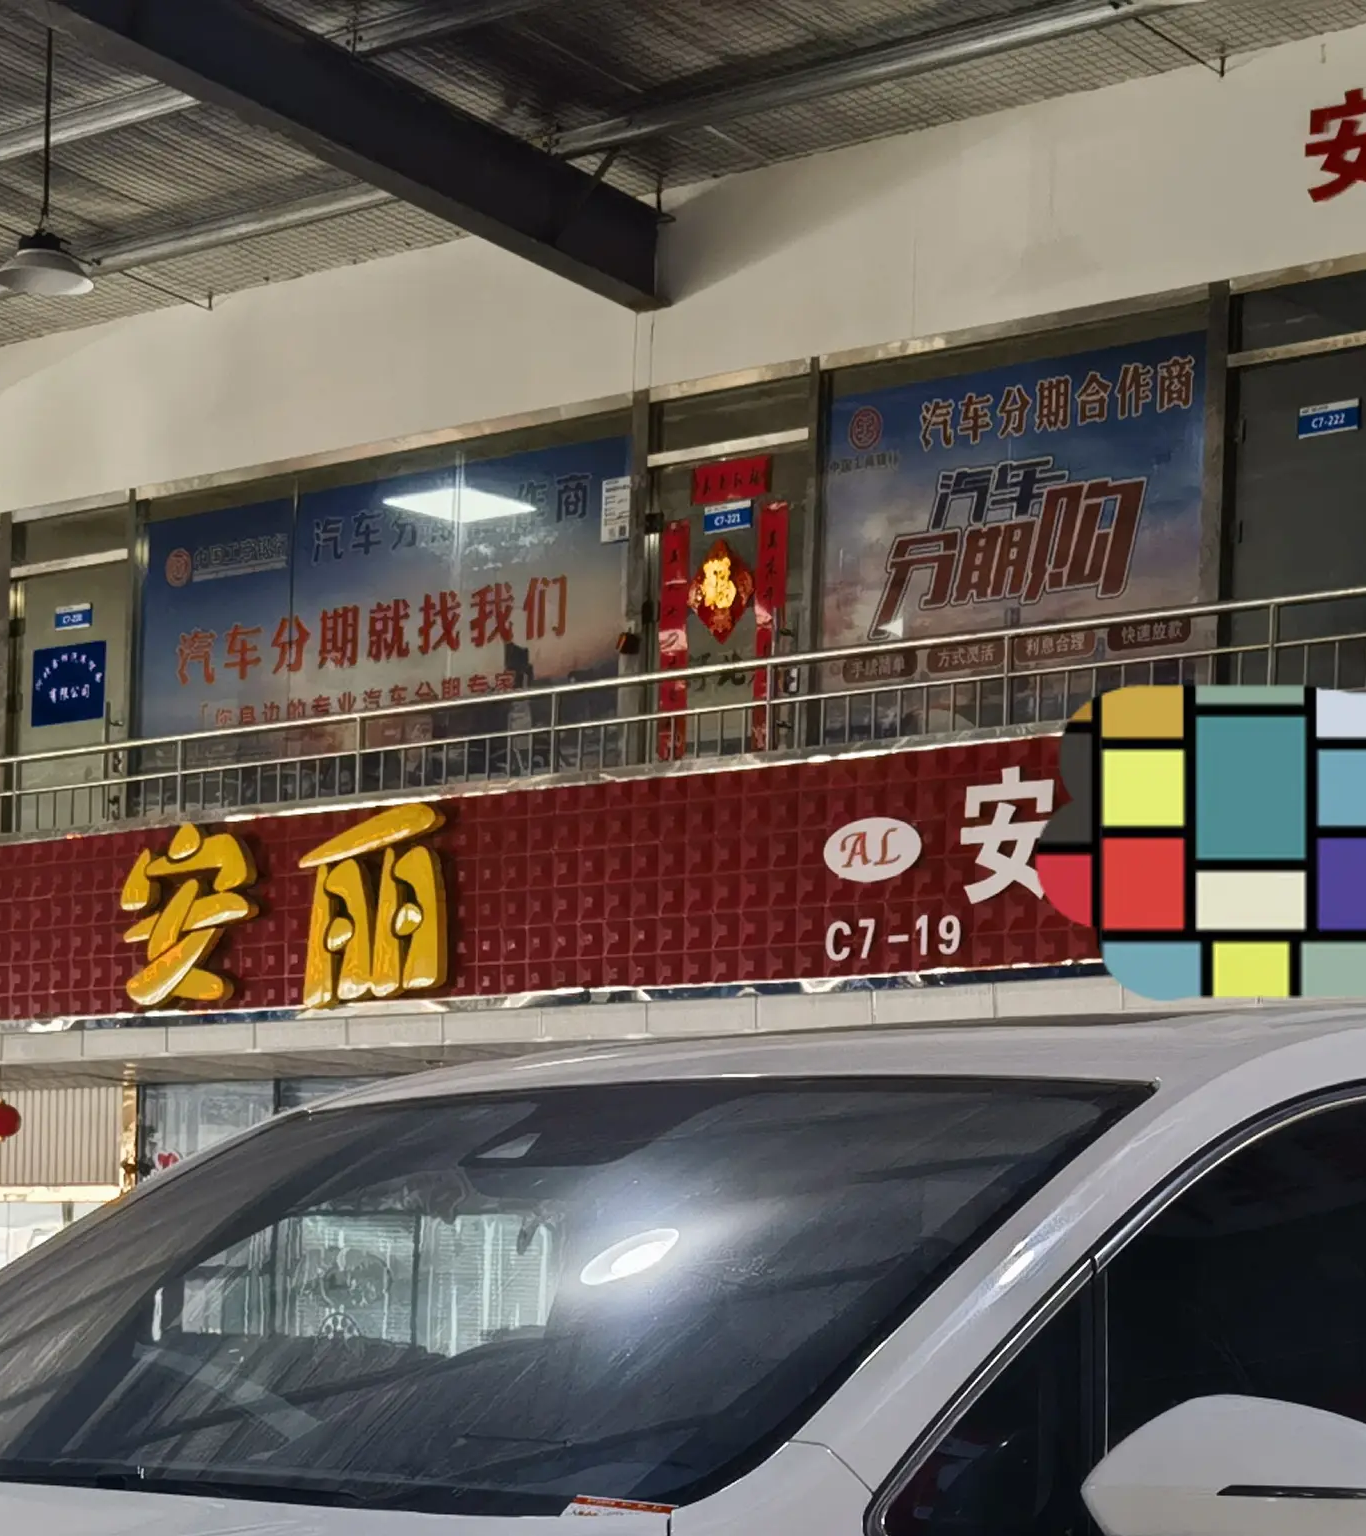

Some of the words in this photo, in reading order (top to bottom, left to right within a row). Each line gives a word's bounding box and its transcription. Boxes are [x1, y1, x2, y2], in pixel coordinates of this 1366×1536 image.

[919, 355, 1195, 450] 汽车分期合作商
[1311, 412, 1345, 429] C7-222
[714, 513, 742, 527] C7-221
[868, 477, 1147, 641] 分期购
[176, 574, 568, 687] 汽车分期就找我们
[1026, 633, 1086, 656] 利息合理
[839, 827, 902, 869] AL
[960, 766, 1054, 905] 安
[120, 803, 446, 1008] 安丽
[825, 914, 962, 961] C7-19
